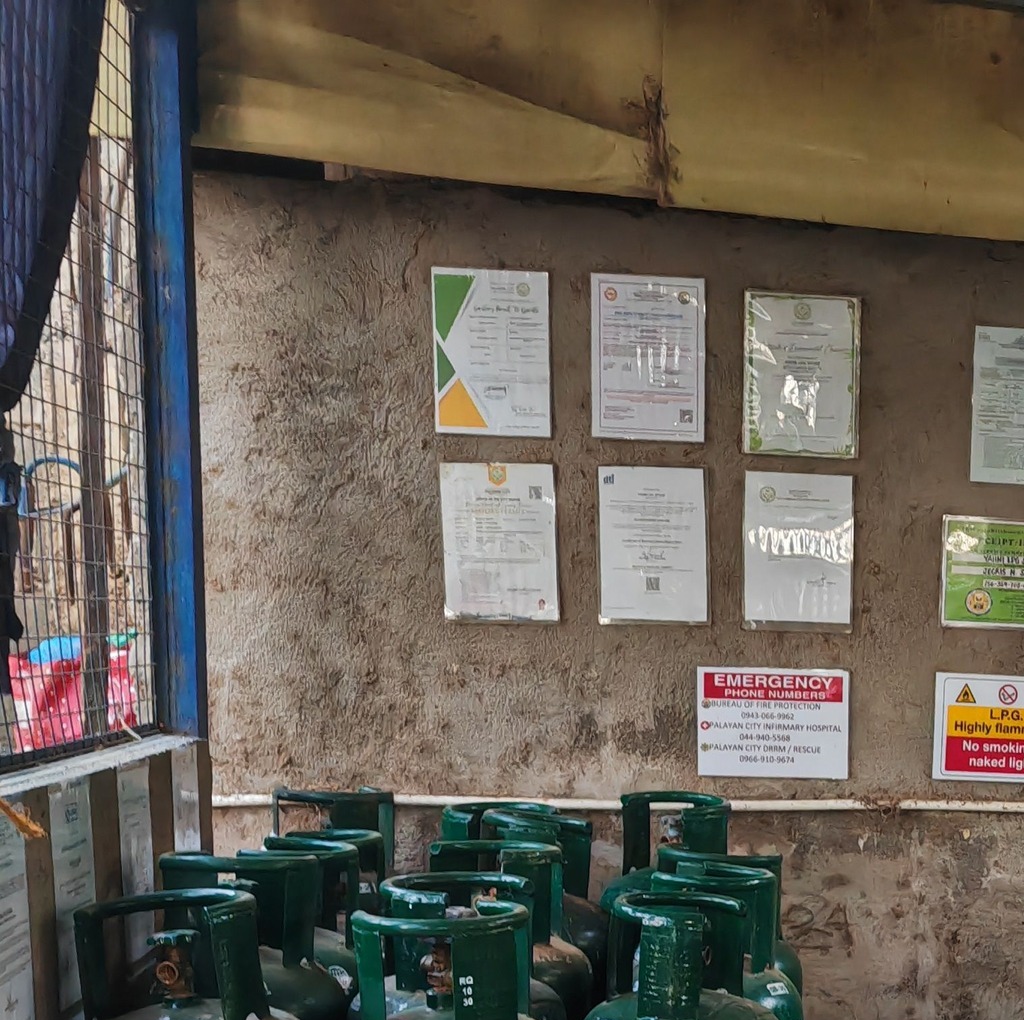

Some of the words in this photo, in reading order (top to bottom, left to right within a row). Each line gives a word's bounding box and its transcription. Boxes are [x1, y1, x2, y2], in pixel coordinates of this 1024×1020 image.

[714, 674, 834, 690] EMERGENCY
[724, 689, 765, 699] PHONE
[768, 690, 826, 700] NUMBERS
[711, 700, 742, 708] BUREAU
[756, 702, 772, 710] FIRE
[774, 702, 821, 710] PROTECTION
[989, 709, 1024, 722] L.P.G.
[710, 722, 744, 730] PALAYAN
[744, 722, 762, 730] CITY
[762, 723, 804, 732] INFIRMARY
[806, 724, 842, 732] HOSPITAL
[954, 720, 992, 735] Highly
[710, 744, 744, 752] PALAYAN
[744, 744, 762, 752] CITY
[792, 746, 821, 754] RESCUE
[962, 740, 980, 752] No
[968, 756, 1006, 768] naked
[459, 976, 474, 986] RQ
[462, 986, 472, 996] 10
[462, 997, 474, 1006] 30
